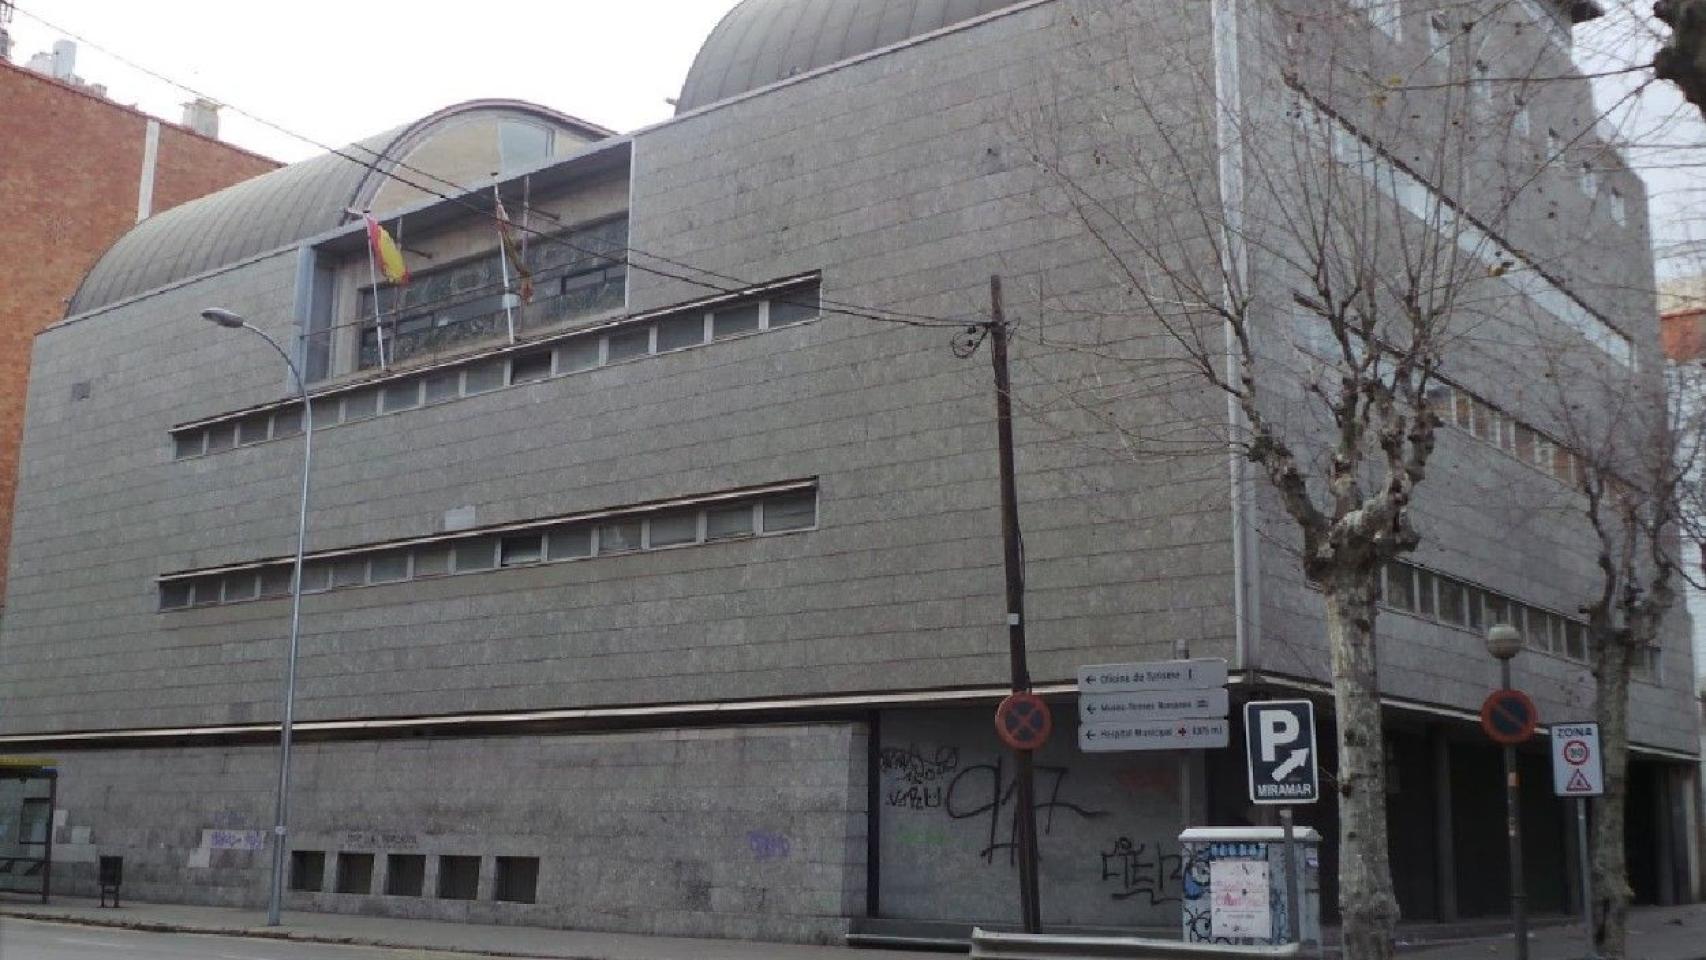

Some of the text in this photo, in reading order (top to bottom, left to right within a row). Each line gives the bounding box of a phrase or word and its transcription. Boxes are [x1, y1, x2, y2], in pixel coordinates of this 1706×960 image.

[1100, 673, 1130, 684] Oficina
[1133, 672, 1145, 682] de
[1100, 727, 1132, 739] Hospital
[1134, 727, 1173, 738] Municipal
[1260, 709, 1300, 762] P
[1558, 728, 1593, 738] ZONA
[1257, 783, 1312, 797] MIRAMAR
